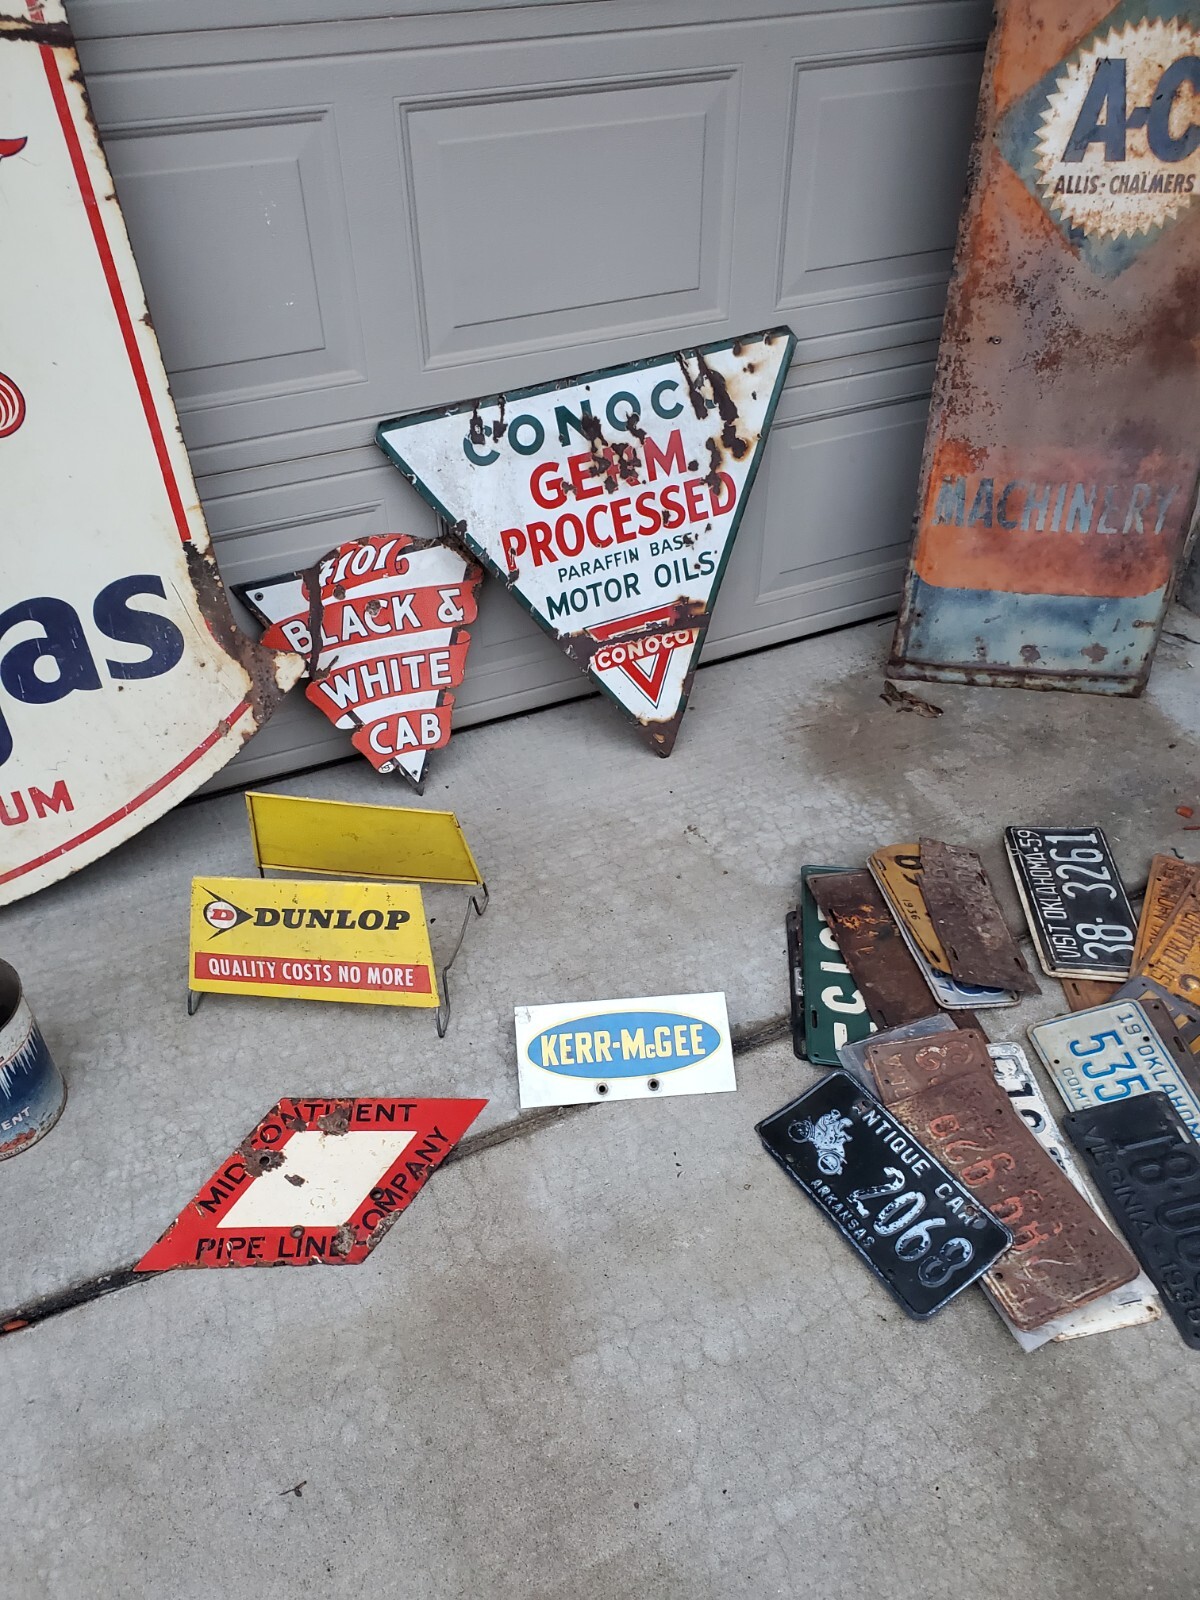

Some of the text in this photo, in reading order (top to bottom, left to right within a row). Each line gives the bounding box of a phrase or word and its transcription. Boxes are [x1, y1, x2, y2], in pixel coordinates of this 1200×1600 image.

[1061, 56, 1200, 163] A-C
[463, 369, 726, 466] CONOC
[500, 471, 737, 571] PROCESSED
[931, 475, 1180, 536] MACHINERY
[546, 551, 715, 620] MOTOR OILS
[558, 546, 639, 583] PARAFFIN
[281, 588, 464, 654] BLACK &
[597, 629, 690, 668] CONOCO
[0, 574, 185, 767] as
[319, 651, 452, 710] WHITE
[369, 713, 442, 755] CAB
[253, 907, 411, 931] DUNLOP
[902, 898, 921, 921] 1936
[1049, 924, 1081, 959] VISIT
[208, 957, 414, 987] QUALITY COSTS NO MORE
[541, 1024, 706, 1067] KERR-McGEE
[0, 1106, 31, 1133] ENT
[1137, 1045, 1200, 1142] OKLAHOM
[251, 1103, 417, 1150] ONTIENT
[354, 1126, 449, 1245] OMPANY
[811, 1178, 876, 1248] ARKANSAS
[196, 1235, 266, 1259] PIPE
[846, 1166, 974, 1288] 2068
